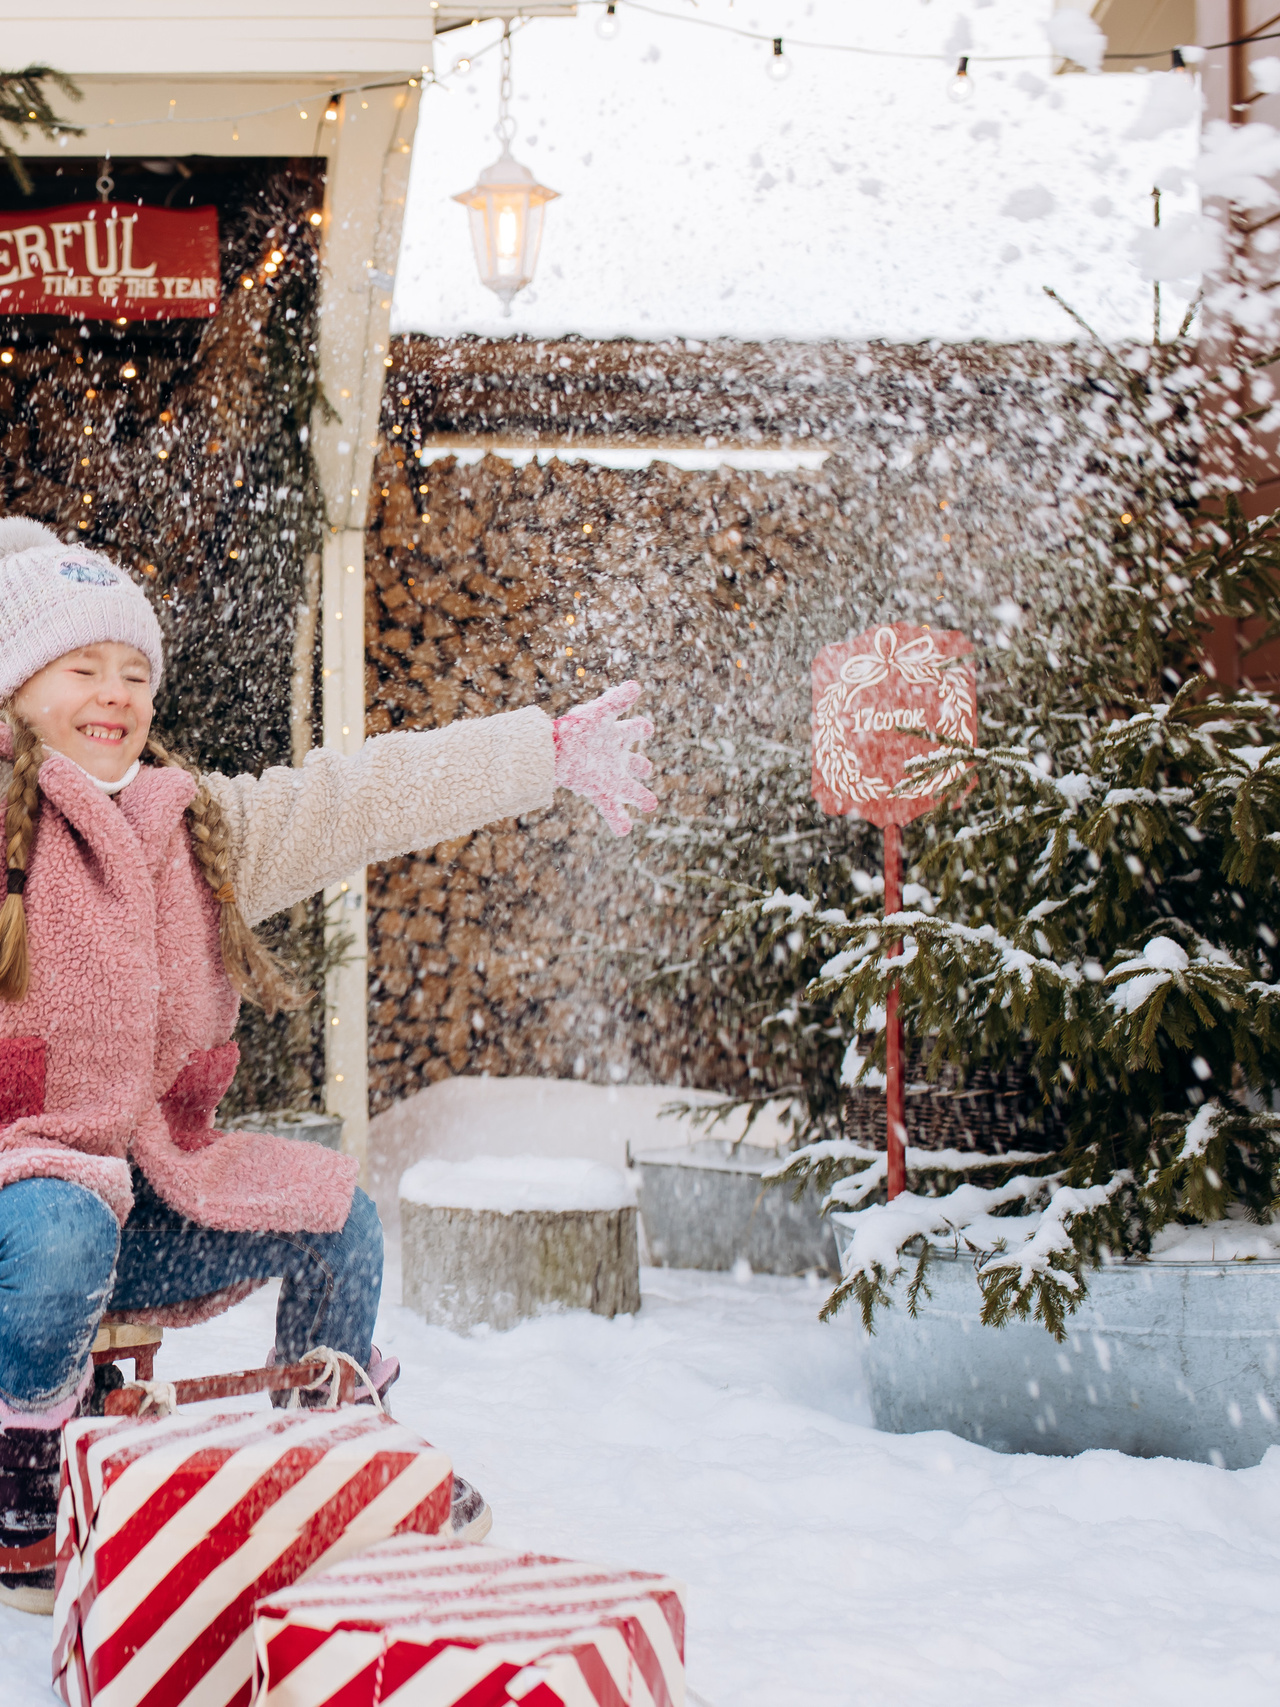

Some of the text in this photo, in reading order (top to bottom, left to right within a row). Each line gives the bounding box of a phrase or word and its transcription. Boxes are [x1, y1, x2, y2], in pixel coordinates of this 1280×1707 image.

[42, 275, 218, 299] TIME OF THE YEAR
